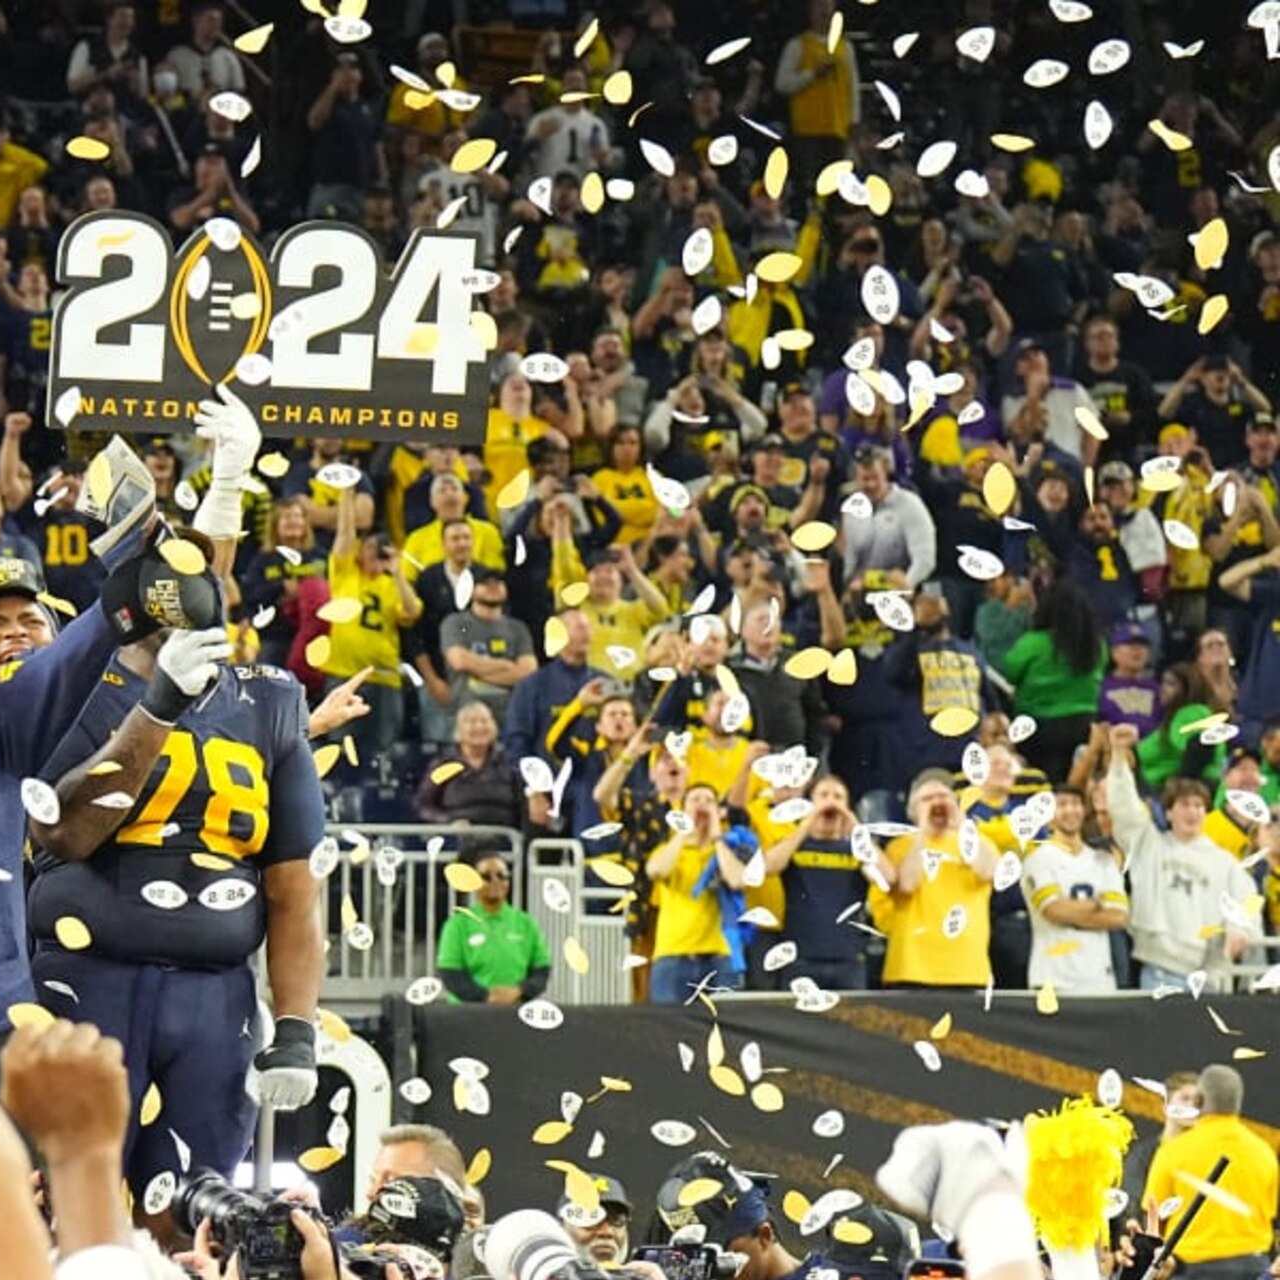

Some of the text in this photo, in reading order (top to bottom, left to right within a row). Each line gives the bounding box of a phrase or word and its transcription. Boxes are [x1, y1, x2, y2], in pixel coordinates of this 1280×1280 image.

[261, 403, 460, 430] CHAMPIONS
[45, 523, 89, 566] 10
[120, 731, 271, 862] 78
